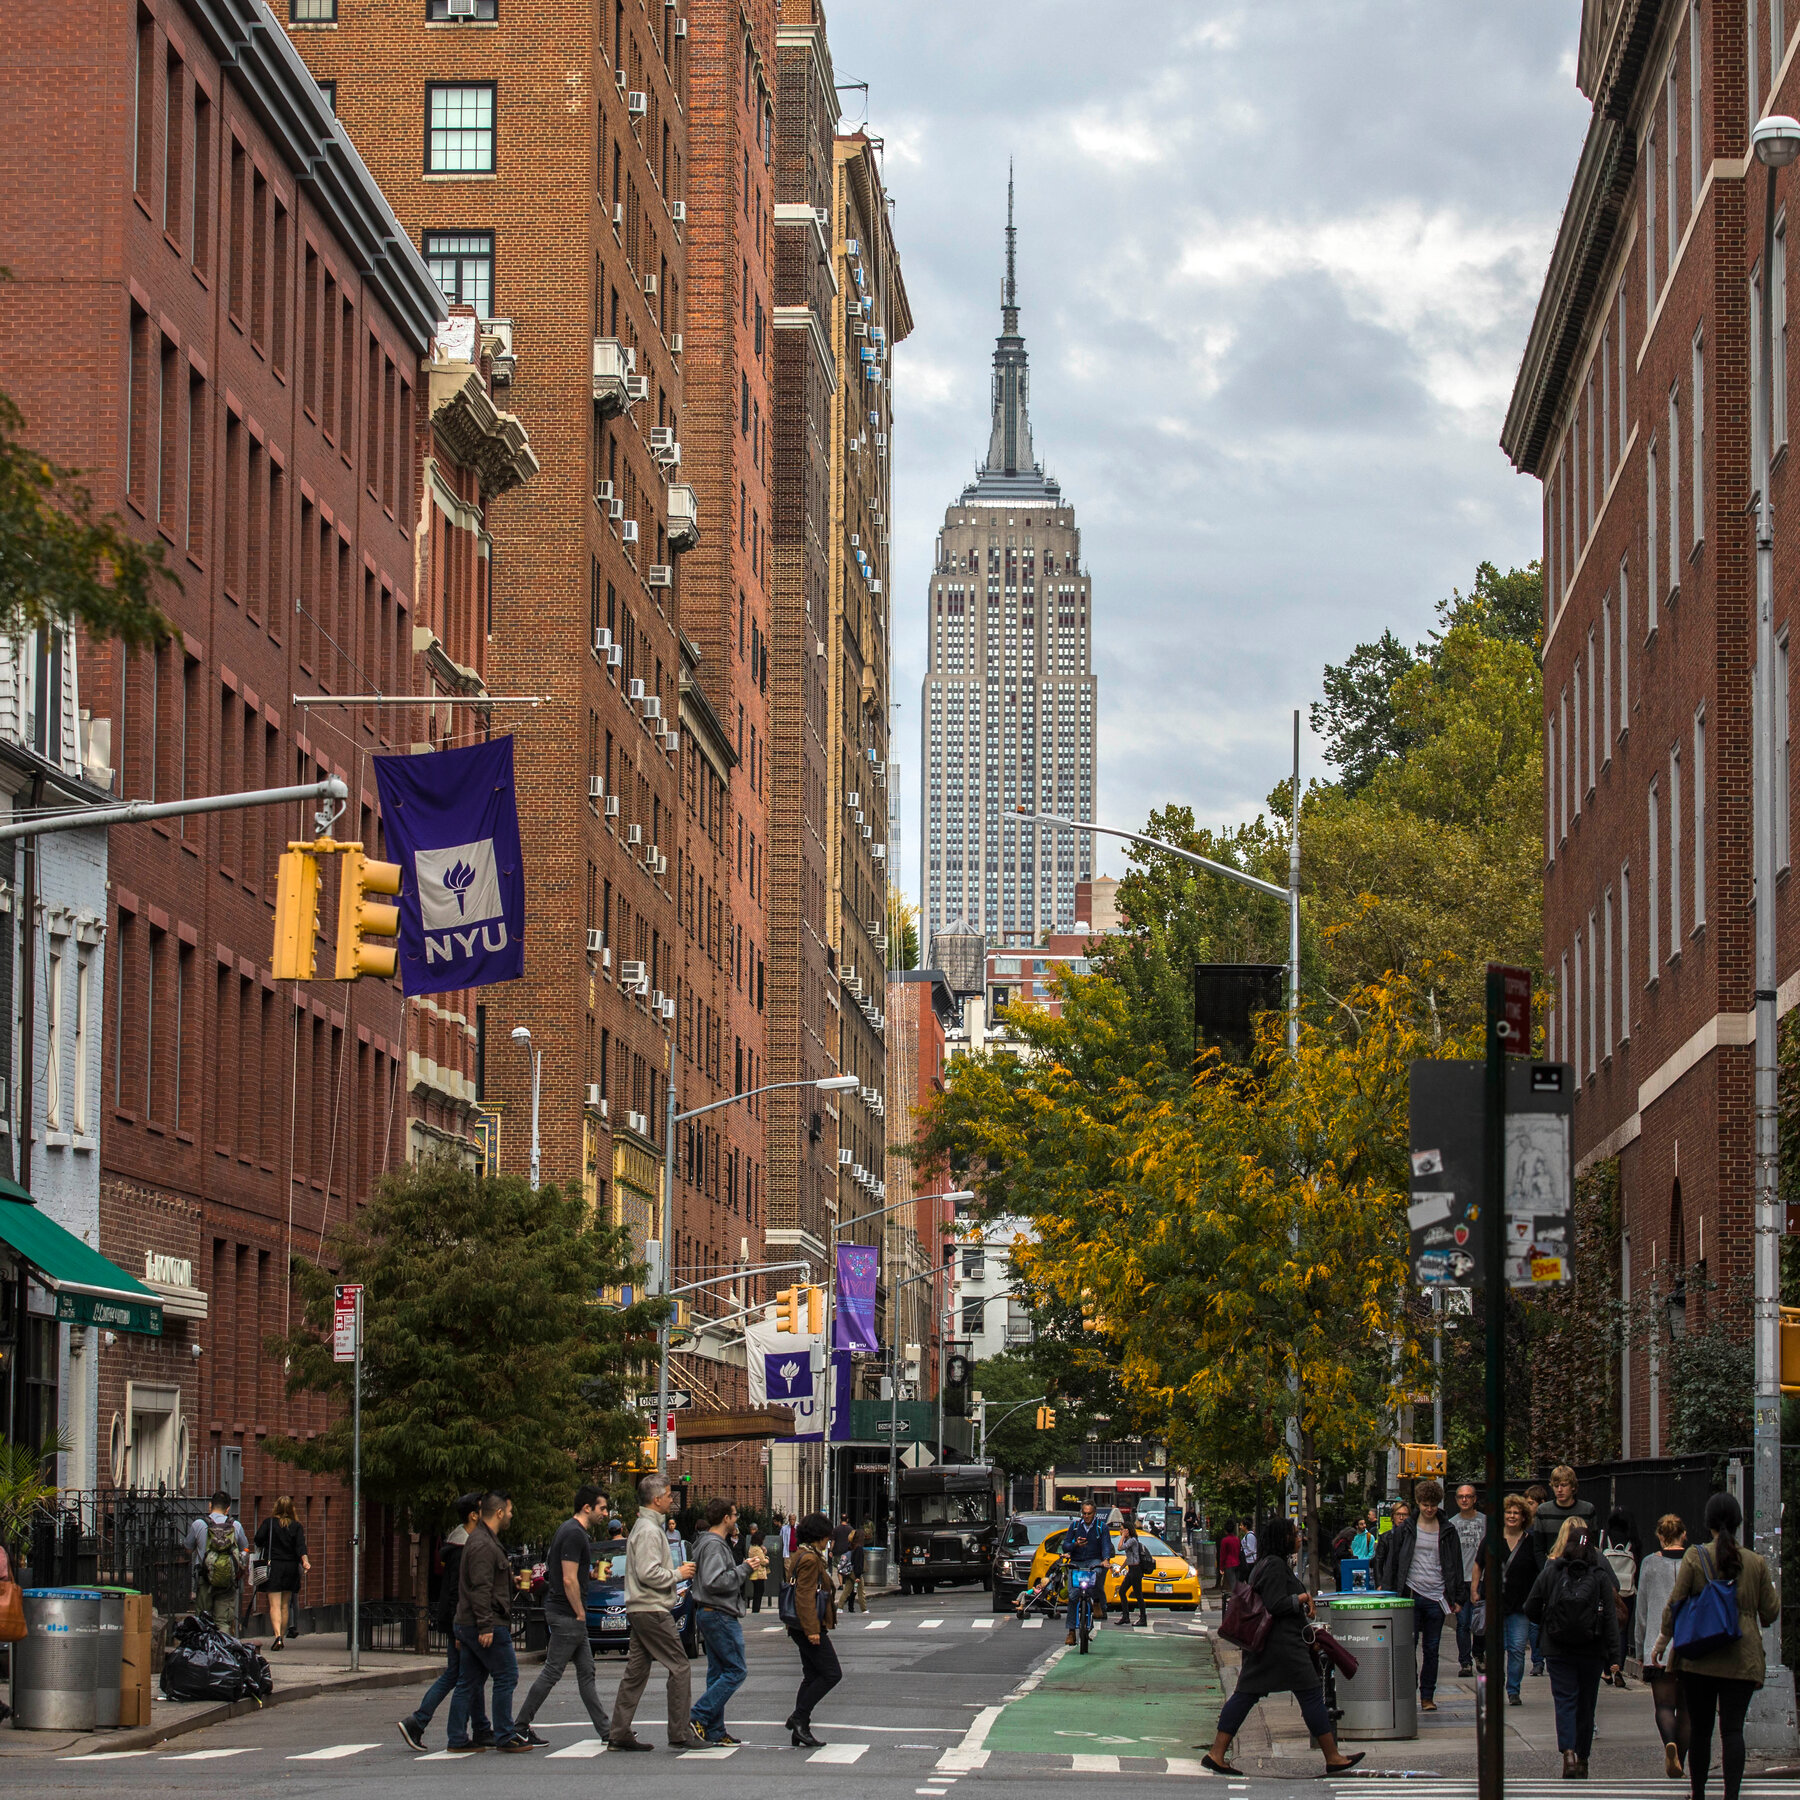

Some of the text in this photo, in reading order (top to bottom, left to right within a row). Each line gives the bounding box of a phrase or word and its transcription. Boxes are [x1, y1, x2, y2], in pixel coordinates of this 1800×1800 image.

[424, 922, 507, 964] NYU
[642, 1396, 677, 1406] ONE AY
